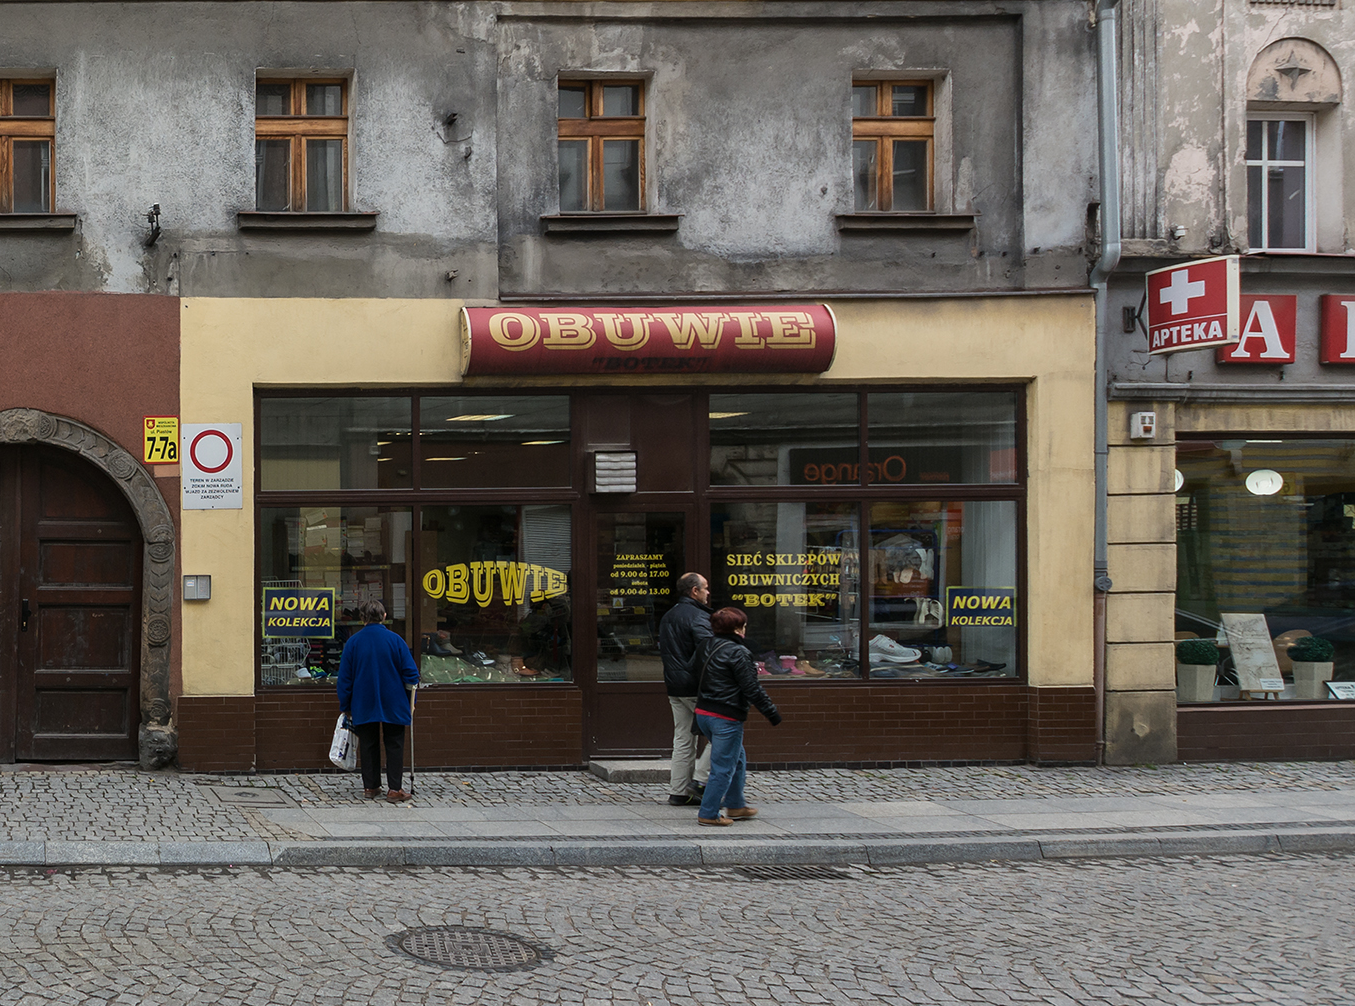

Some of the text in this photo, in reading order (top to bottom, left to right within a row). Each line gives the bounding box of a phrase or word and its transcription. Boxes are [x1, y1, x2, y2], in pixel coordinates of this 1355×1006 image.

[489, 312, 816, 352] OBUWIE
[1152, 320, 1223, 348] APTEKA
[147, 436, 177, 460] 7-7a
[726, 551, 841, 566] SIEĆ SKLEPÓW
[422, 560, 568, 608] OBUWIE
[727, 574, 841, 586] OBUWNICZYCH
[269, 597, 329, 611] NOWA
[952, 595, 1011, 610] NOWA
[267, 617, 331, 627] KOLEKCJA
[951, 616, 1013, 626] KOLEKCJA
